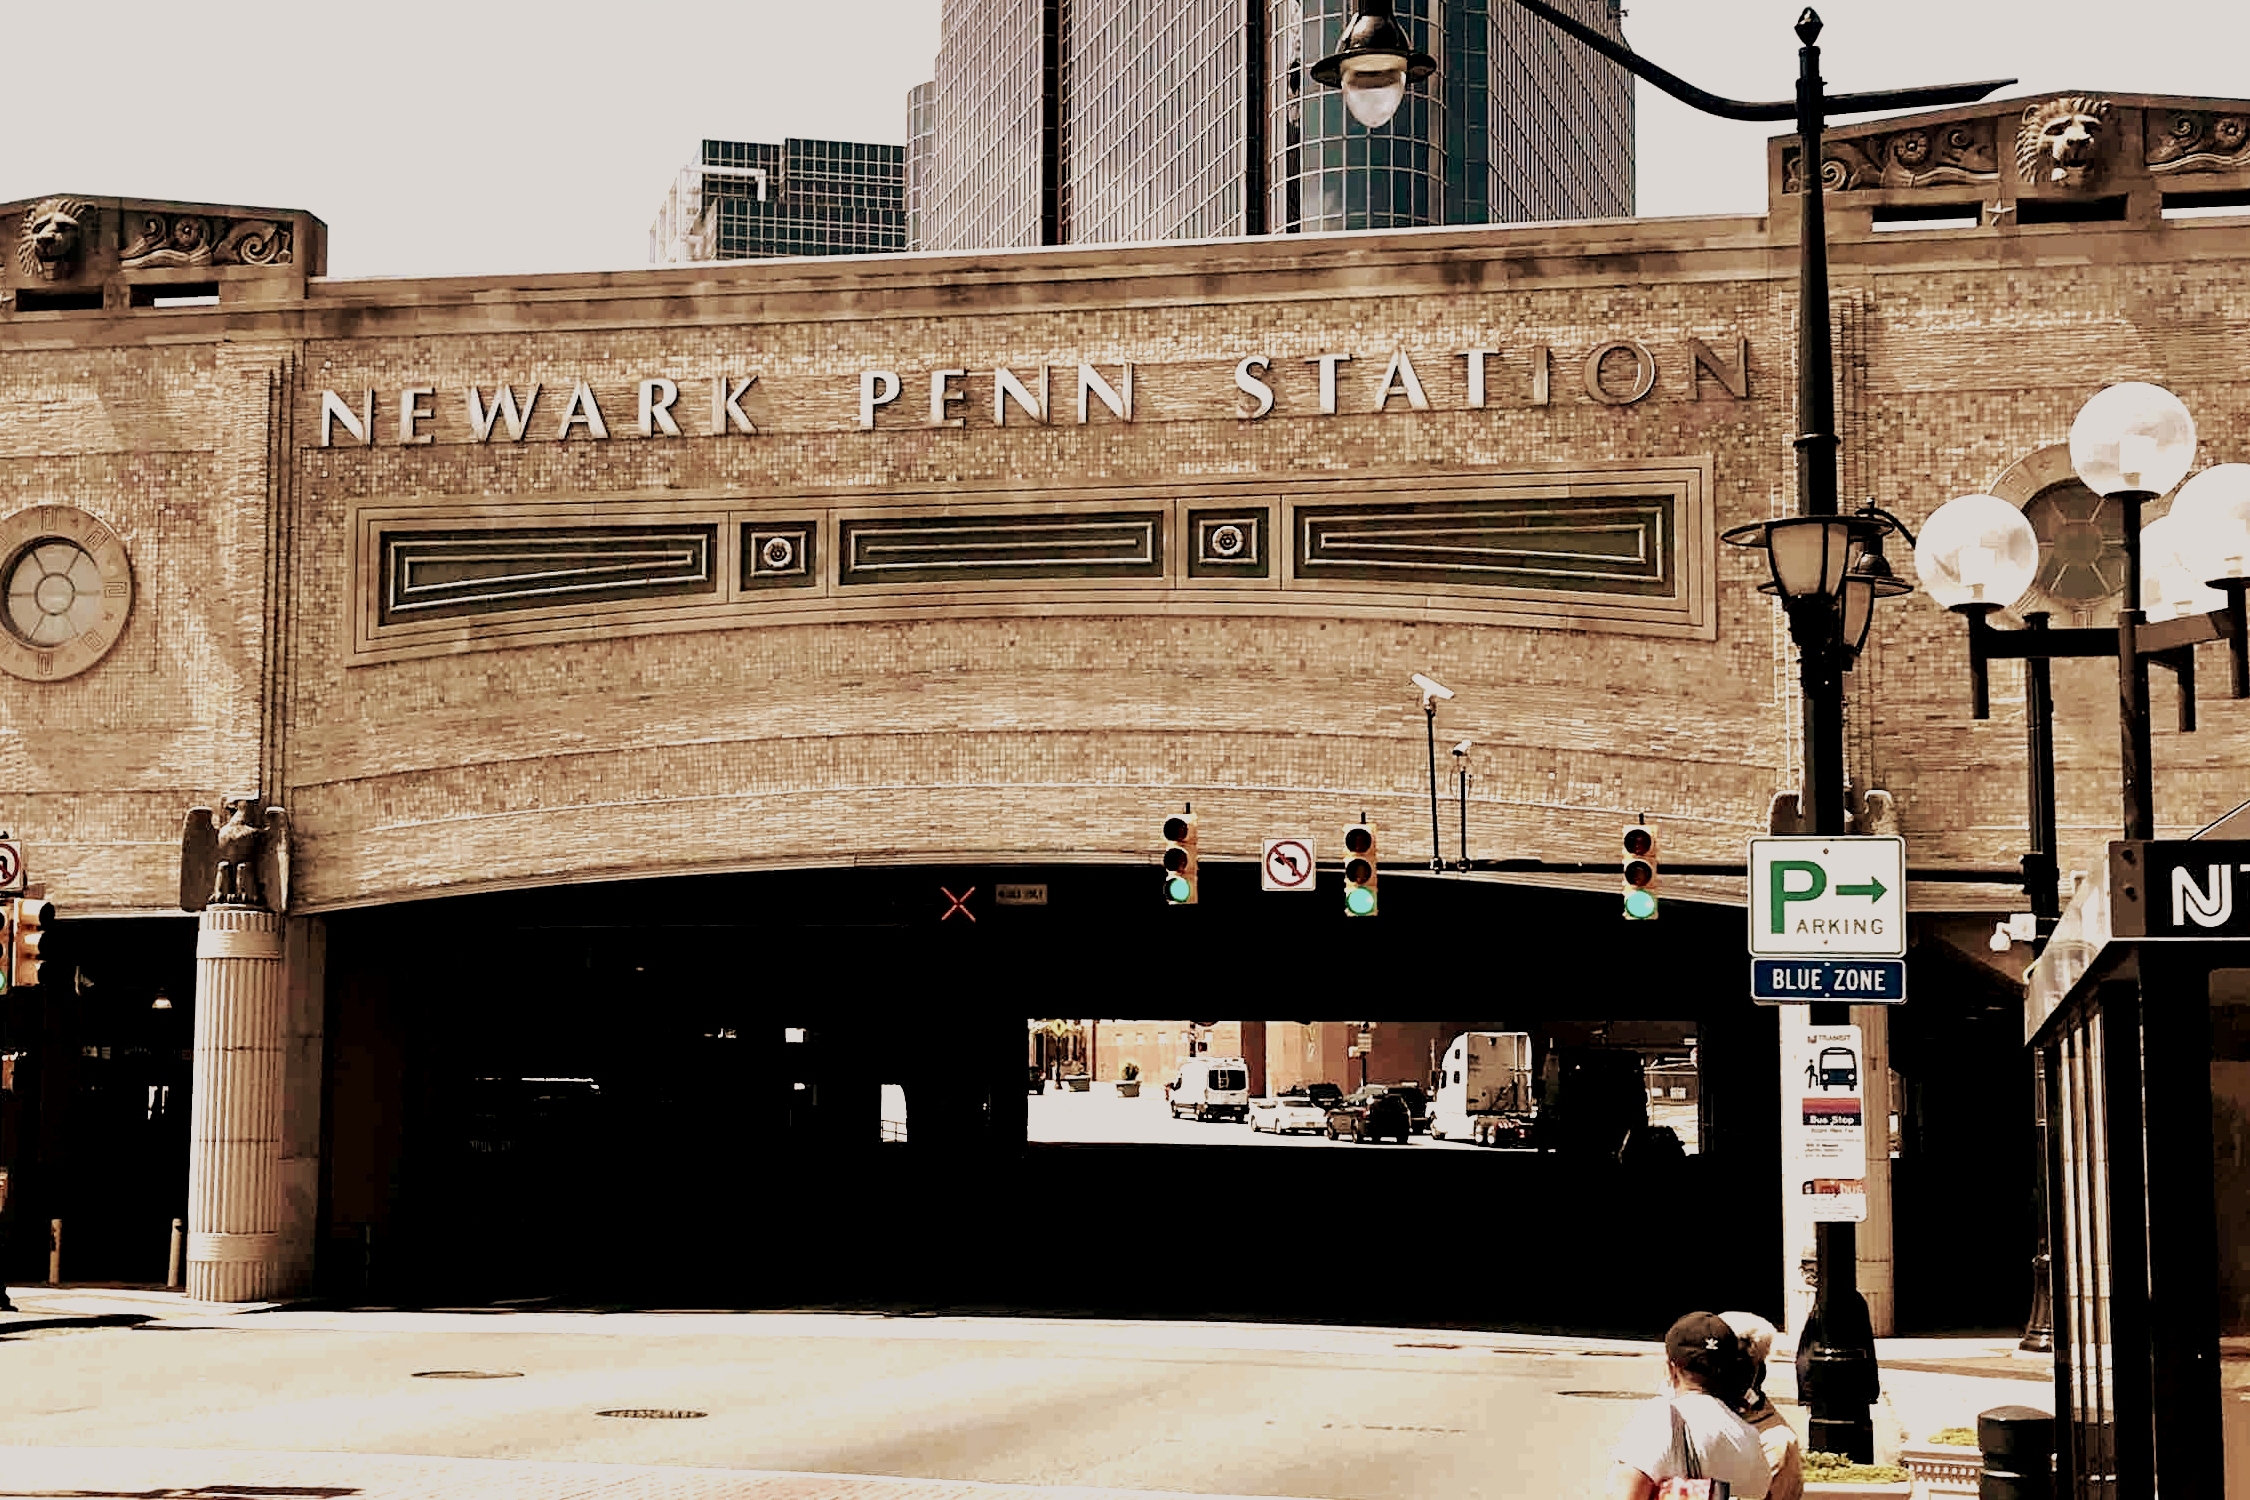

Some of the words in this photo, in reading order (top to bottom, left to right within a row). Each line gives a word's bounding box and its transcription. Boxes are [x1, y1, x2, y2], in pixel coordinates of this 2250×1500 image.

[319, 375, 758, 449] NEWARK
[858, 363, 1134, 431] PENN
[1234, 337, 1750, 422] STATION
[1772, 968, 1823, 990] BLUE
[1833, 969, 1886, 991] ZONE
[1830, 1115, 1855, 1126] Stop
